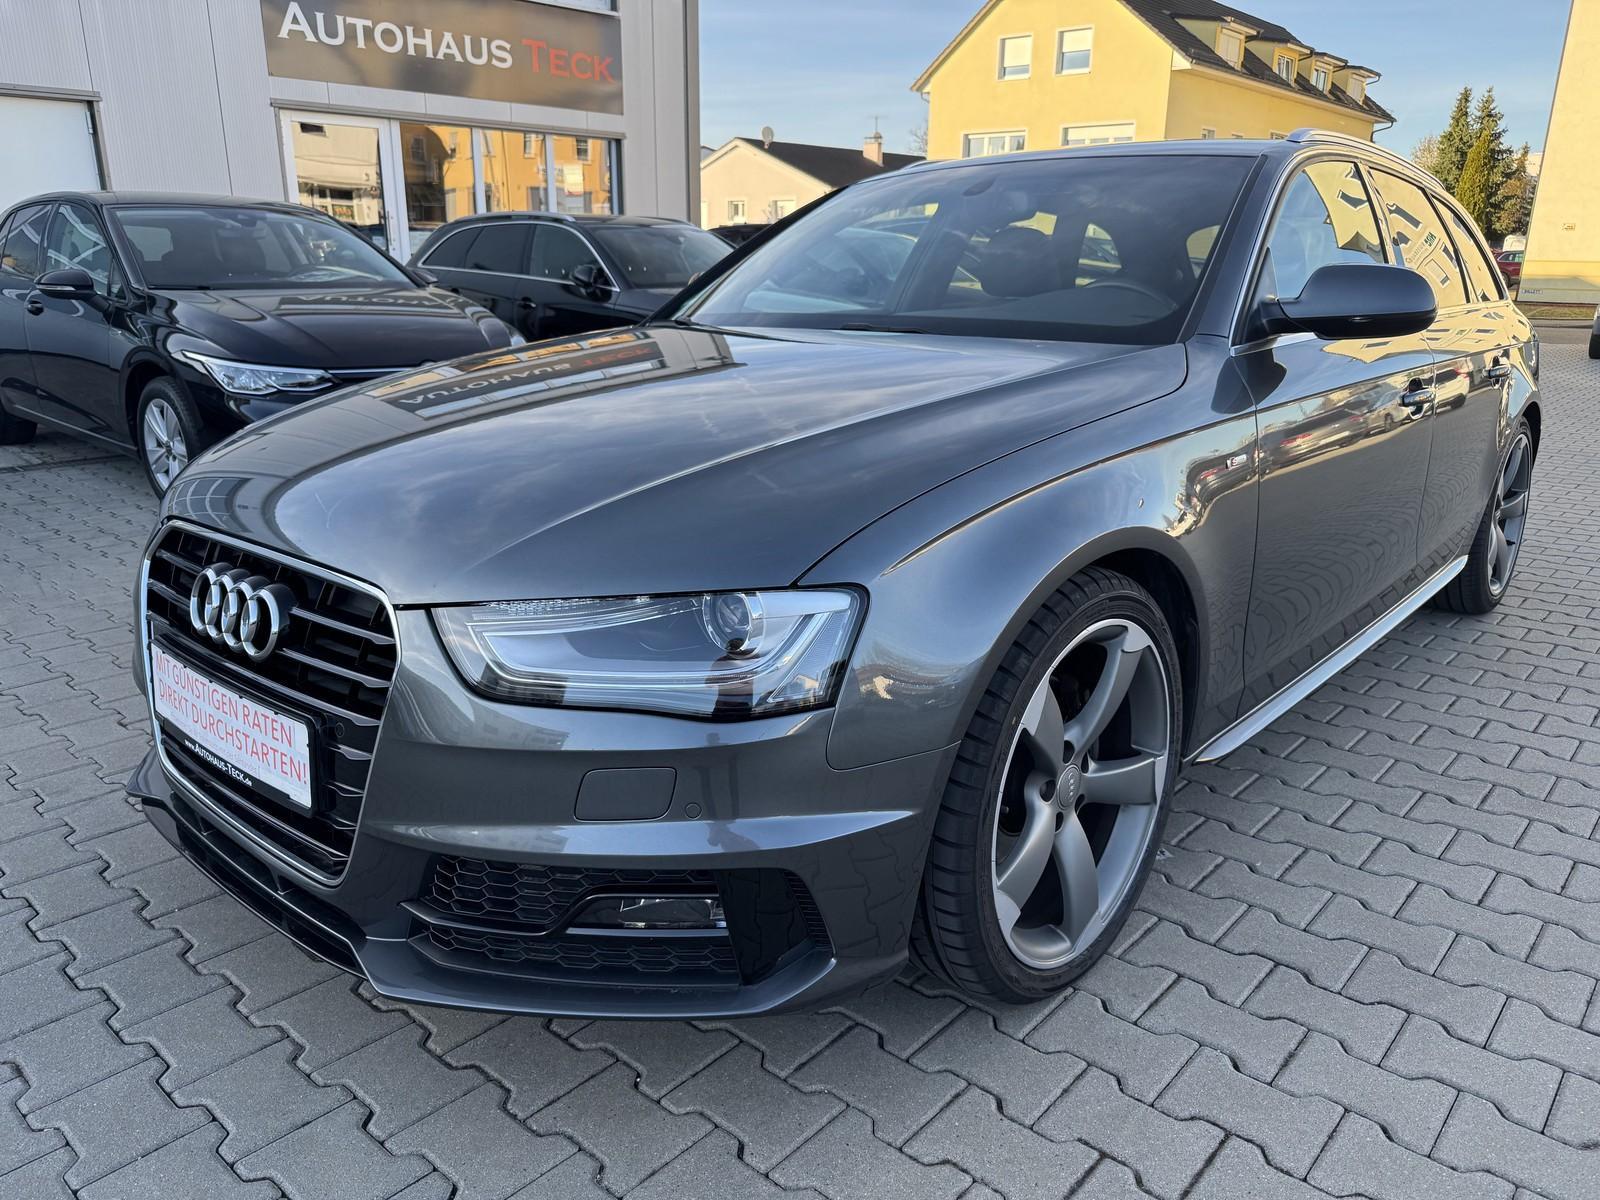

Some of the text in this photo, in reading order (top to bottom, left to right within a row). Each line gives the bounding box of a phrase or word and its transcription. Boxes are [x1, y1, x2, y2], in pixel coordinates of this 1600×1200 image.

[156, 651, 170, 679] MIT
[242, 703, 293, 748] RATEN
[159, 678, 307, 785] DIREKT DURCHSTARTEN!
